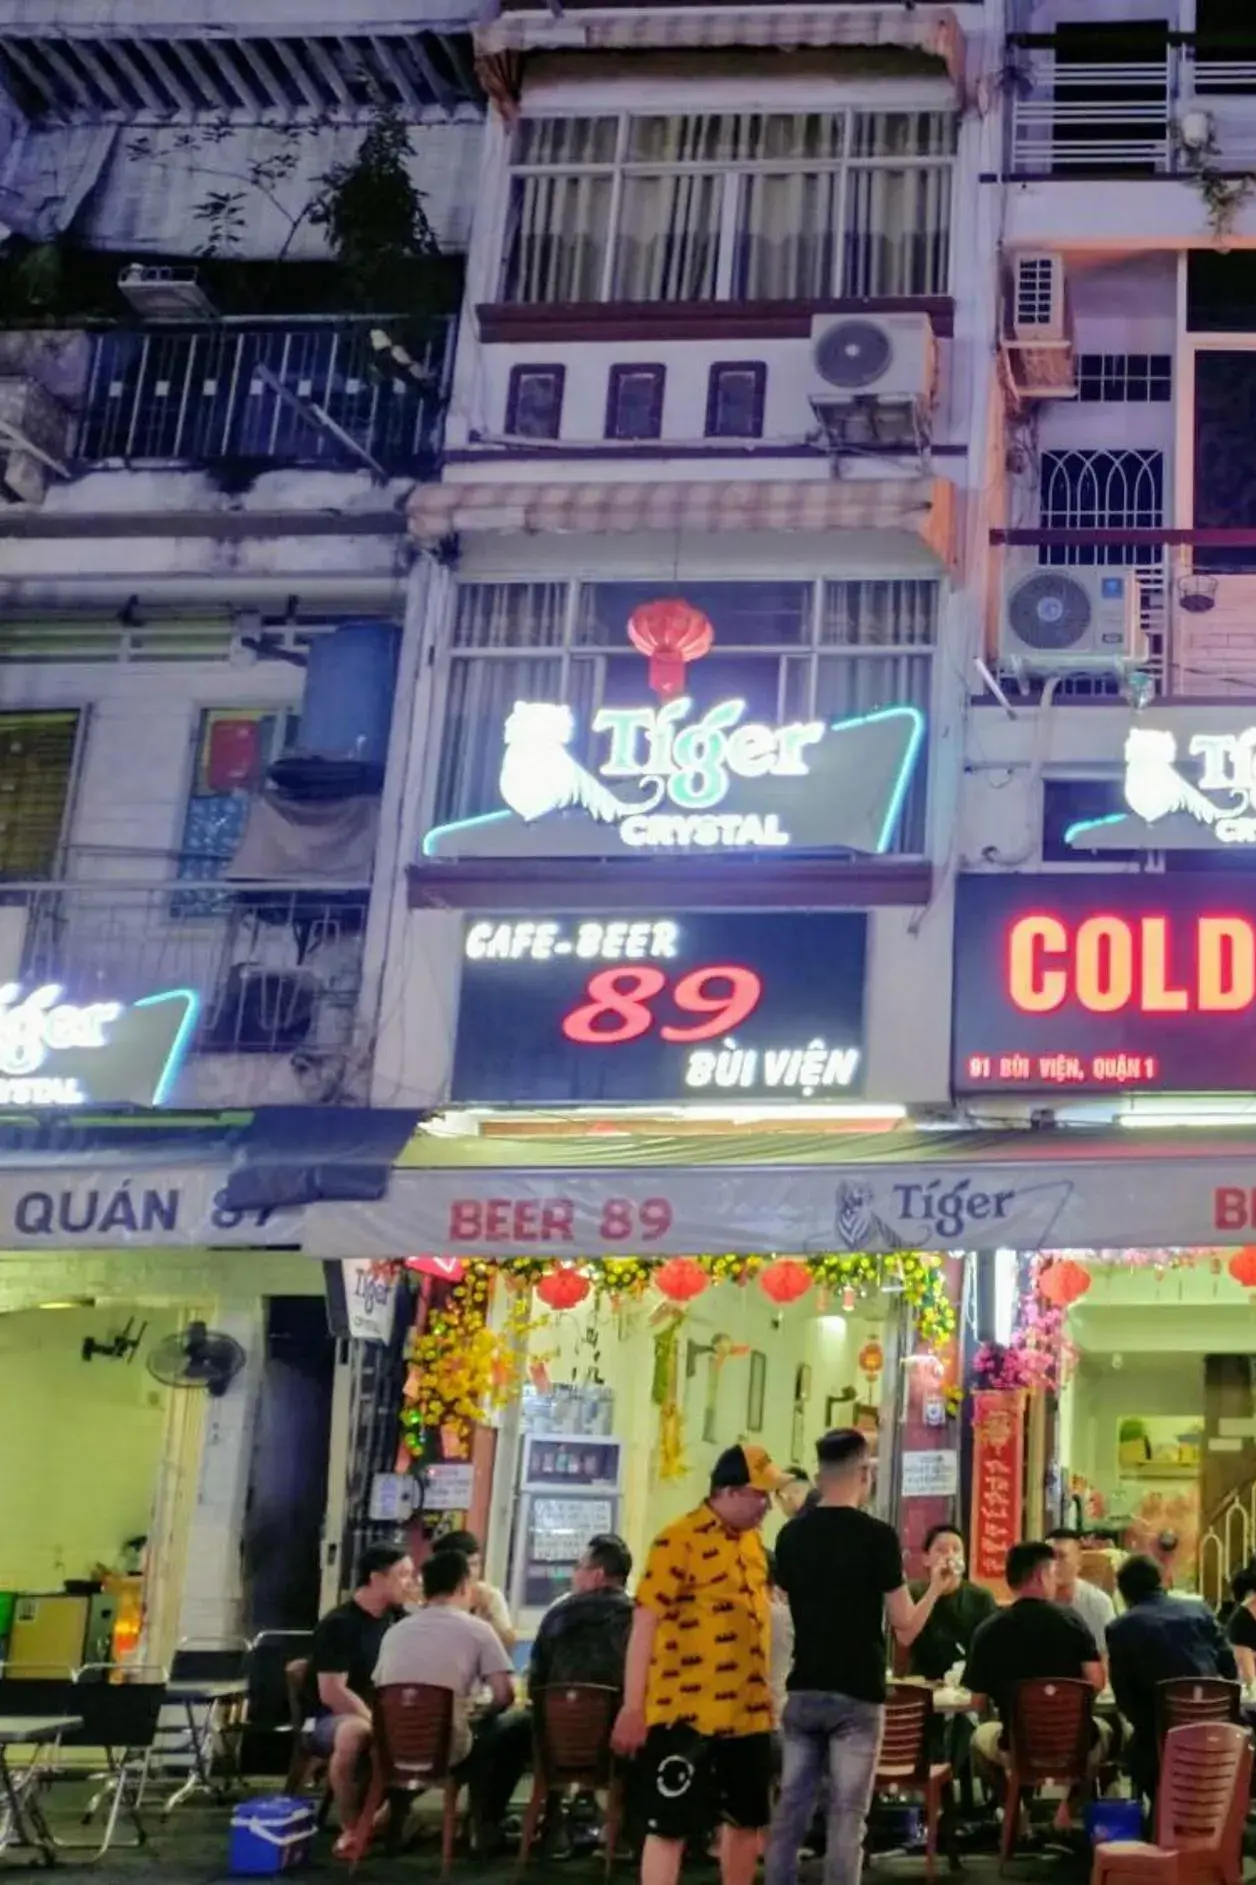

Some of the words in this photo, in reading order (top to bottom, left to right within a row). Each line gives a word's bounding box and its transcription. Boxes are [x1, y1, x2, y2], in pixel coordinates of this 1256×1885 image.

[593, 698, 825, 808] Tiger
[619, 815, 789, 847] CRYSTAL
[1008, 915, 1256, 1014] COLD
[562, 964, 763, 1044] 89
[684, 1037, 758, 1087] BÙI
[764, 1037, 859, 1097] VIỆN
[1143, 1057, 1155, 1078] 1
[14, 1177, 179, 1235] QUÁN
[449, 1197, 579, 1243] BEER
[598, 1196, 674, 1241] 89
[893, 1178, 1016, 1238] Tiger
